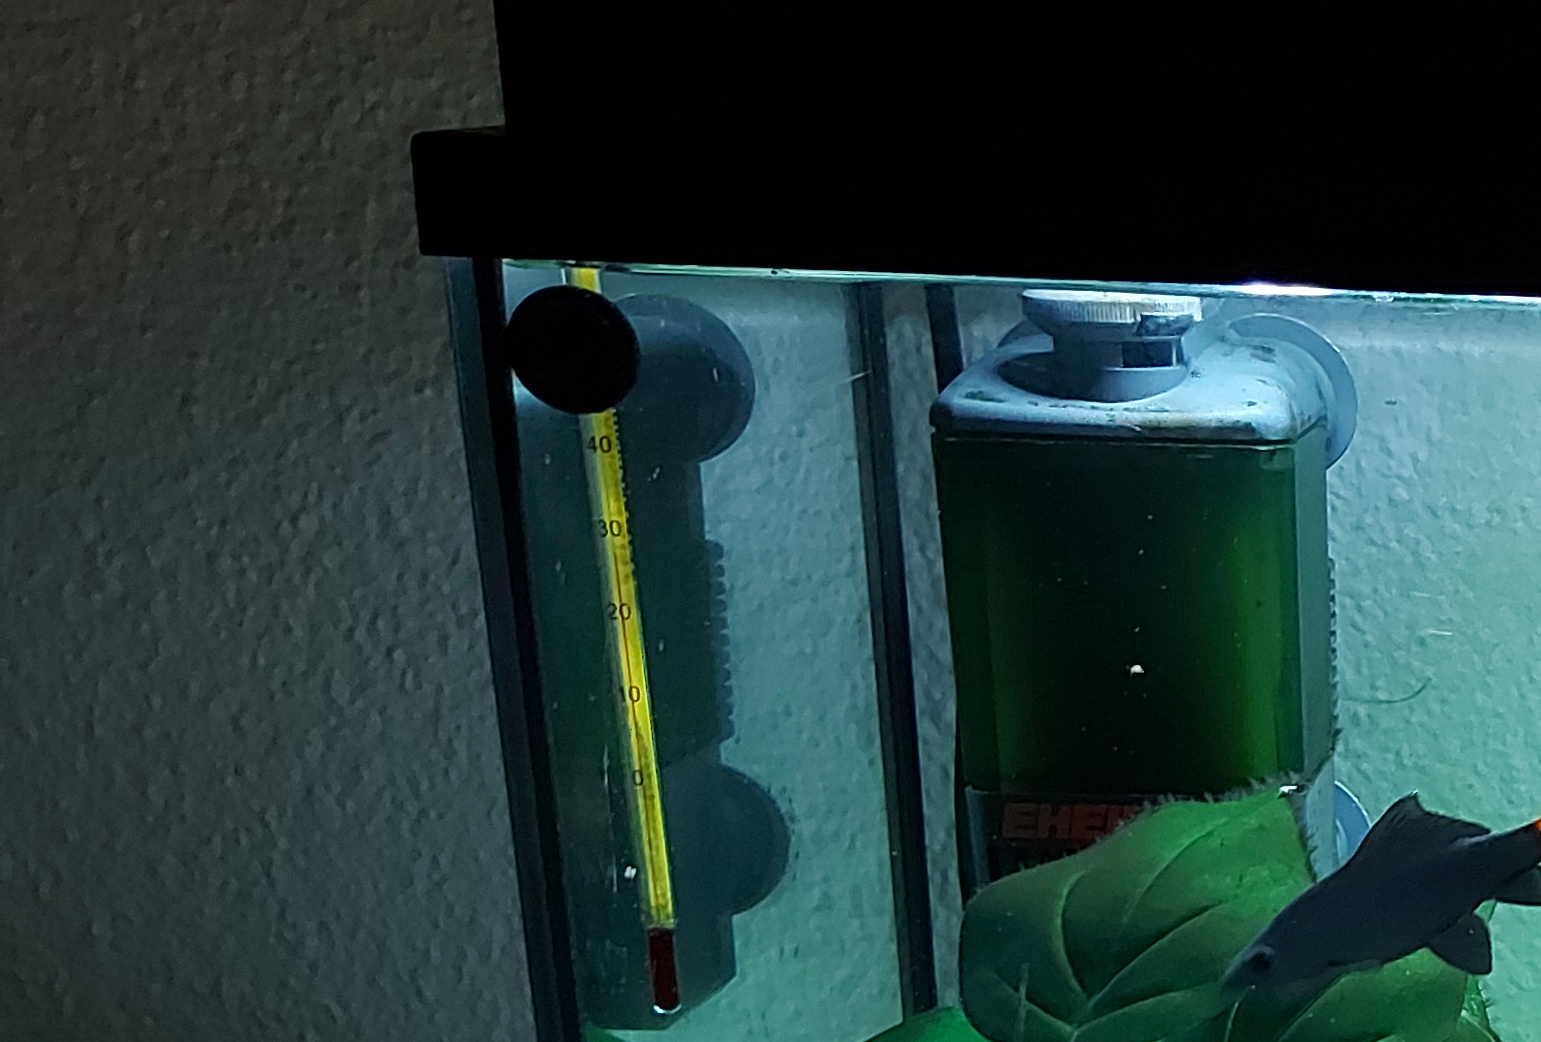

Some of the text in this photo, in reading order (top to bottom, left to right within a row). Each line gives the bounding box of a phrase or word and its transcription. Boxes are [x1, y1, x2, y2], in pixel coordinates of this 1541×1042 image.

[588, 435, 613, 453] 40
[598, 519, 622, 537] 30
[608, 603, 631, 620] 20
[620, 685, 640, 703] 10
[633, 769, 643, 786] 0
[1002, 803, 1141, 845] EHE
